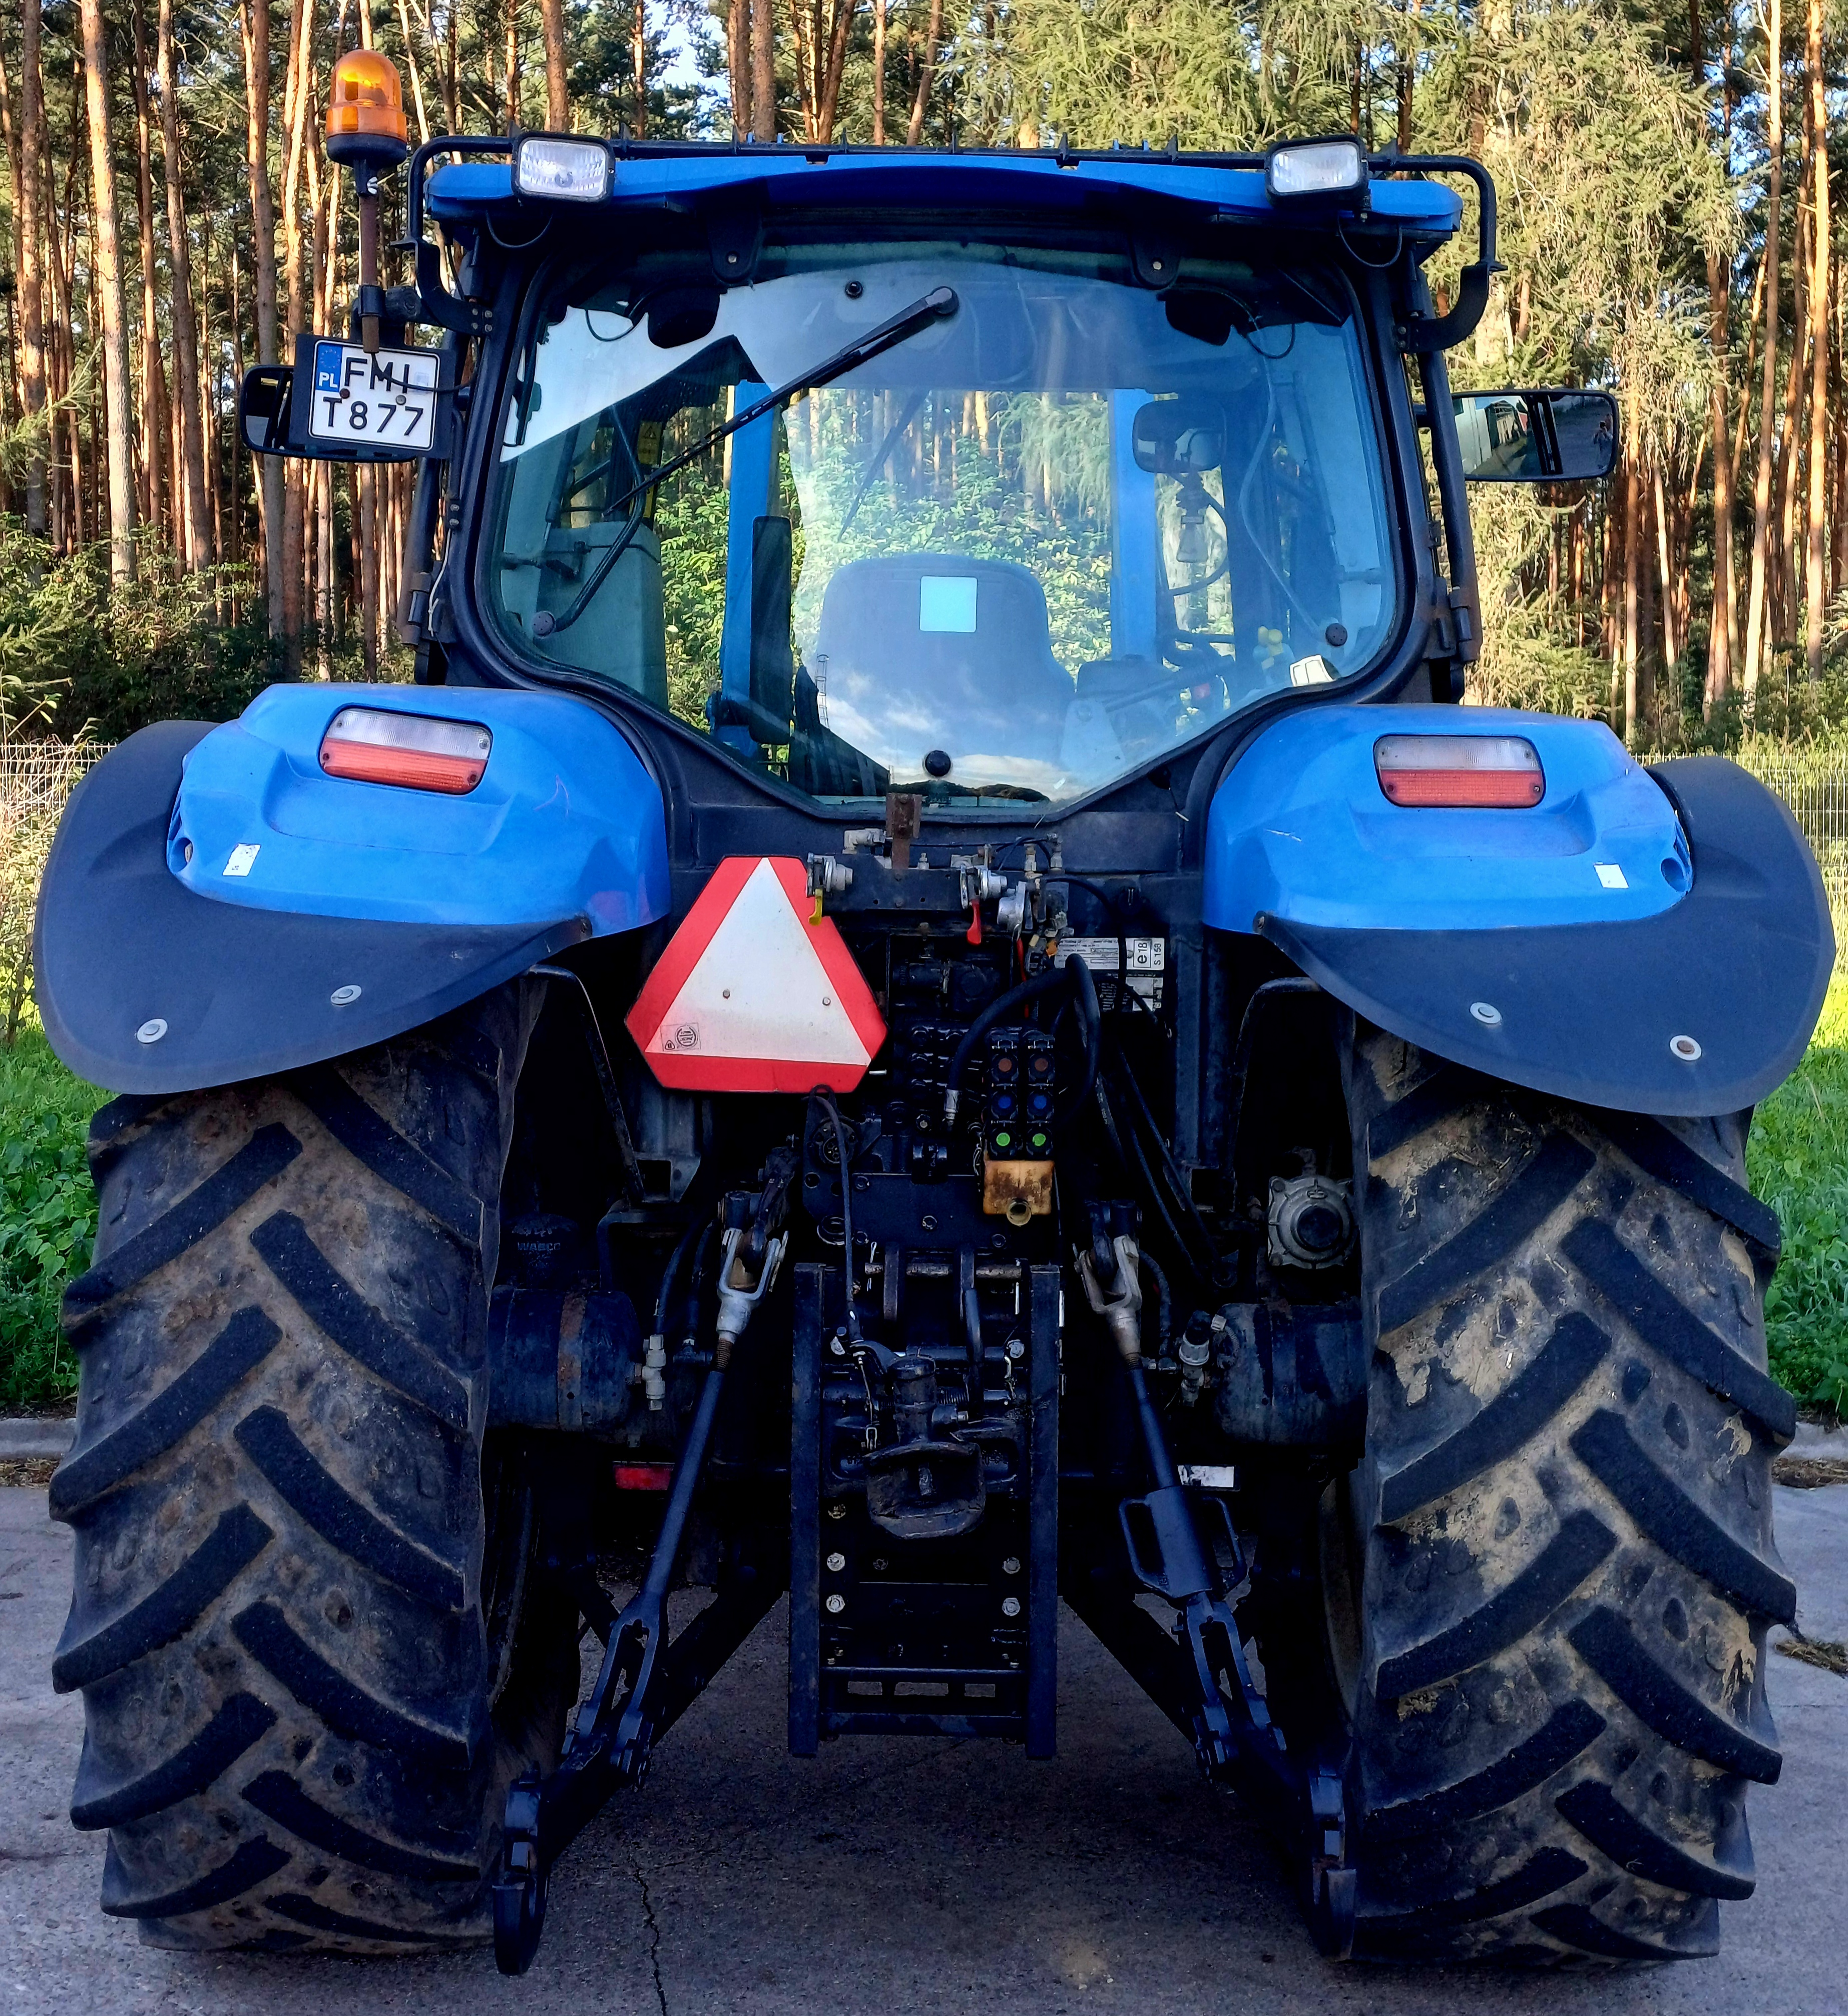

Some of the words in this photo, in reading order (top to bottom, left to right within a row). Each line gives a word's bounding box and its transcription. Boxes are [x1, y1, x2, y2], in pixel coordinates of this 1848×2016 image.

[318, 372, 338, 388] PL
[344, 356, 410, 393] FMI
[323, 396, 423, 436] T877
